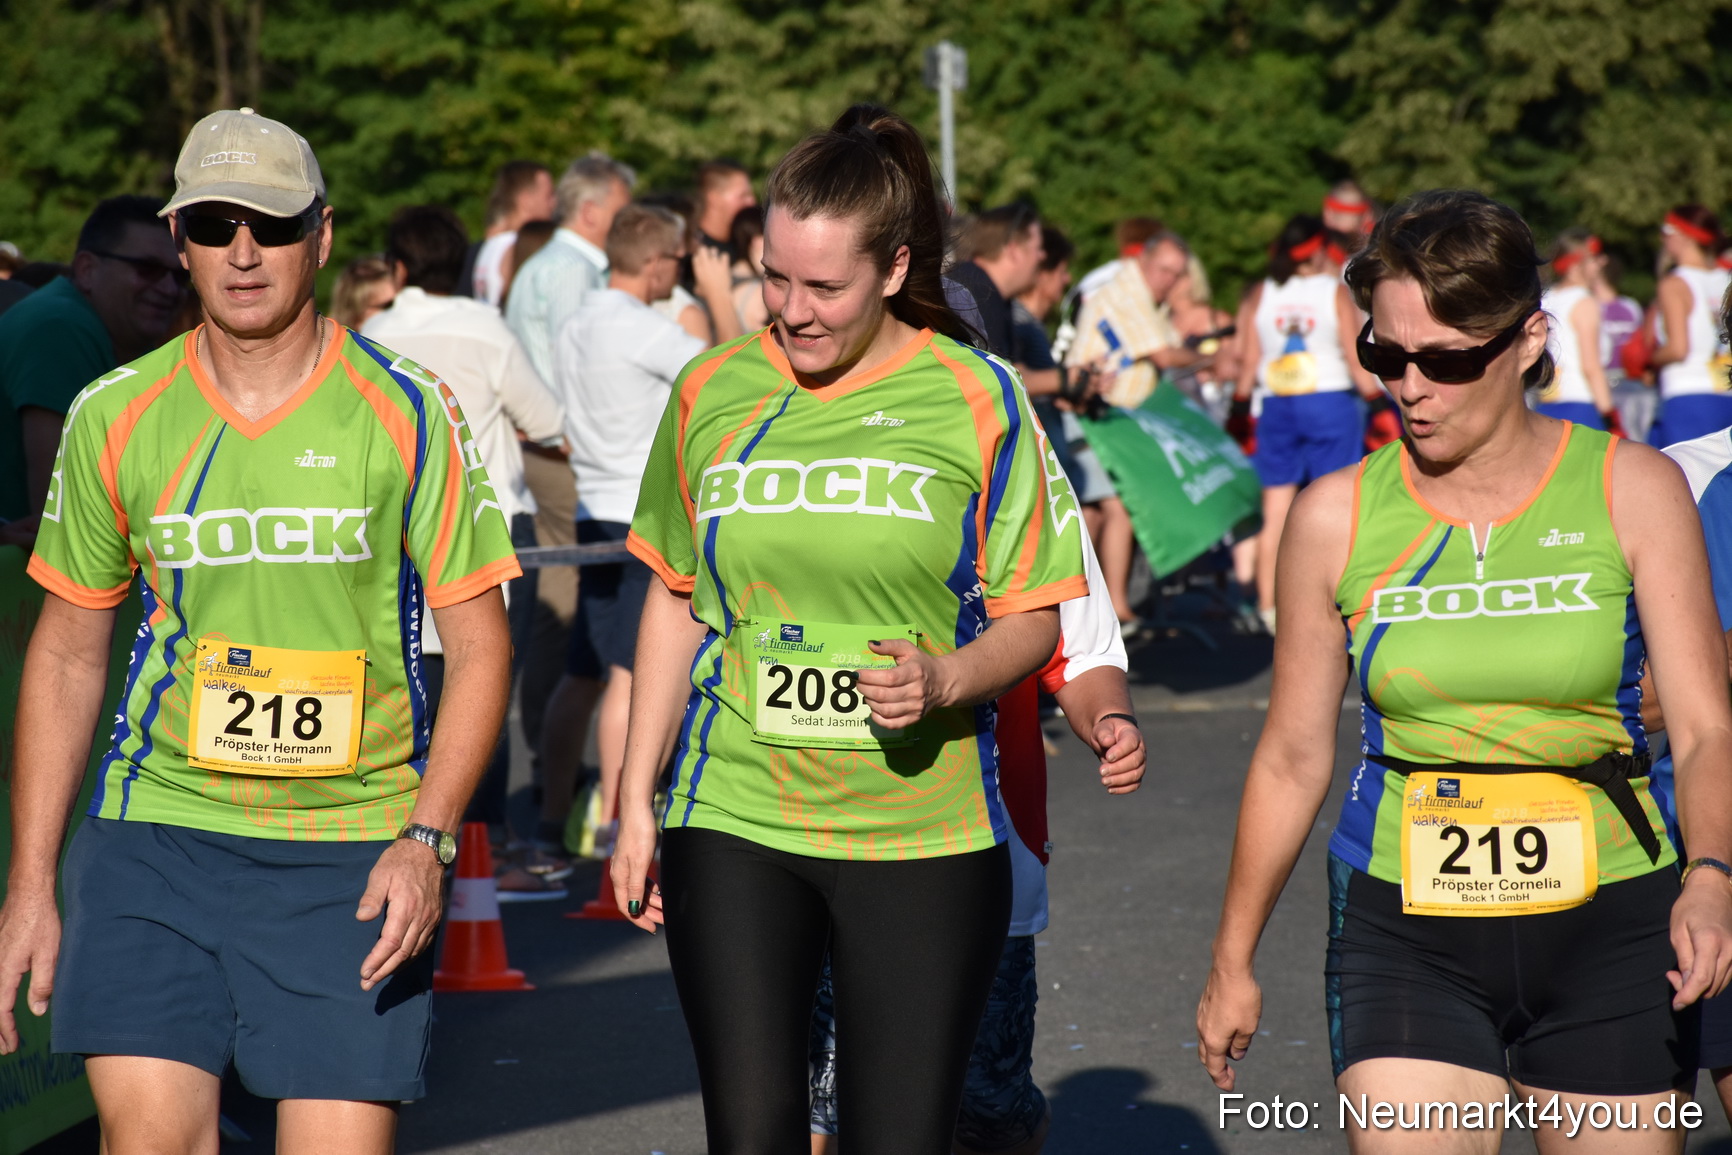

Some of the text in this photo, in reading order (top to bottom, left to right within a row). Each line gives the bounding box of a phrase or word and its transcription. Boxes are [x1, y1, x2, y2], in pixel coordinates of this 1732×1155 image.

[201, 151, 256, 168] BOCK
[696, 457, 938, 523] BOCK
[146, 507, 373, 569] BOCK
[1372, 572, 1601, 624] BOCK
[770, 637, 825, 654] firmenlauf
[830, 653, 862, 664] 2018
[215, 661, 273, 679] firmenlauf
[277, 678, 311, 690] 2018
[766, 664, 869, 714] 208
[223, 691, 323, 741] 218
[791, 714, 868, 728] Sedat Jasmin
[214, 736, 332, 755] Pröpster Hermann
[241, 752, 264, 763] Bock
[266, 755, 271, 763] 1
[274, 755, 302, 765] GmbH
[1425, 794, 1484, 810] firmenlauf
[1492, 807, 1528, 820] 2018
[1439, 826, 1548, 875] 219
[1432, 877, 1562, 893] Pröpster Cornelia
[1461, 892, 1530, 903] Bock 1 GmbH
